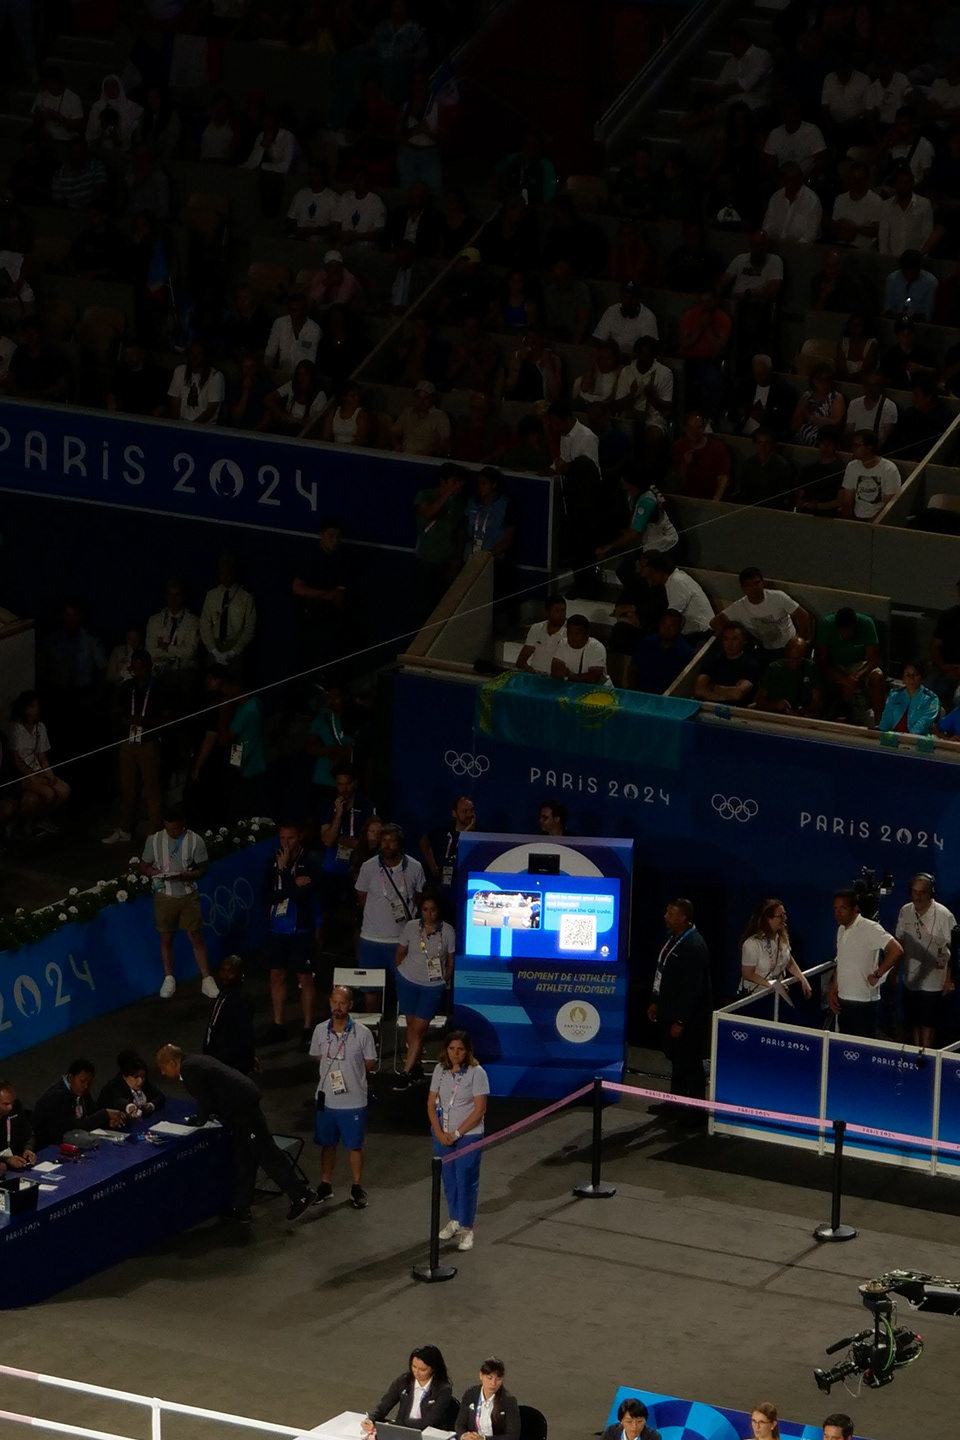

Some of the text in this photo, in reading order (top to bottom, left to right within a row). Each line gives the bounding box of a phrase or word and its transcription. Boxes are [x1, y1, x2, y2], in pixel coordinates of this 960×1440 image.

[172, 452, 318, 511] 2024
[608, 780, 670, 805] 2024
[880, 824, 944, 851] 2024
[518, 970, 560, 981] MOMENT
[561, 973, 572, 981] DE
[535, 983, 616, 994] ATHLETE MOMENT
[787, 1040, 810, 1052] 2024
[897, 1059, 919, 1071] 2024
[662, 1093, 678, 1101] 2024
[880, 1130, 895, 1138] 2024
[193, 1141, 210, 1154] 2024
[152, 1160, 169, 1173] 2024
[110, 1181, 126, 1195] 2024
[68, 1200, 85, 1214] 2024
[24, 1220, 41, 1235] 2024
